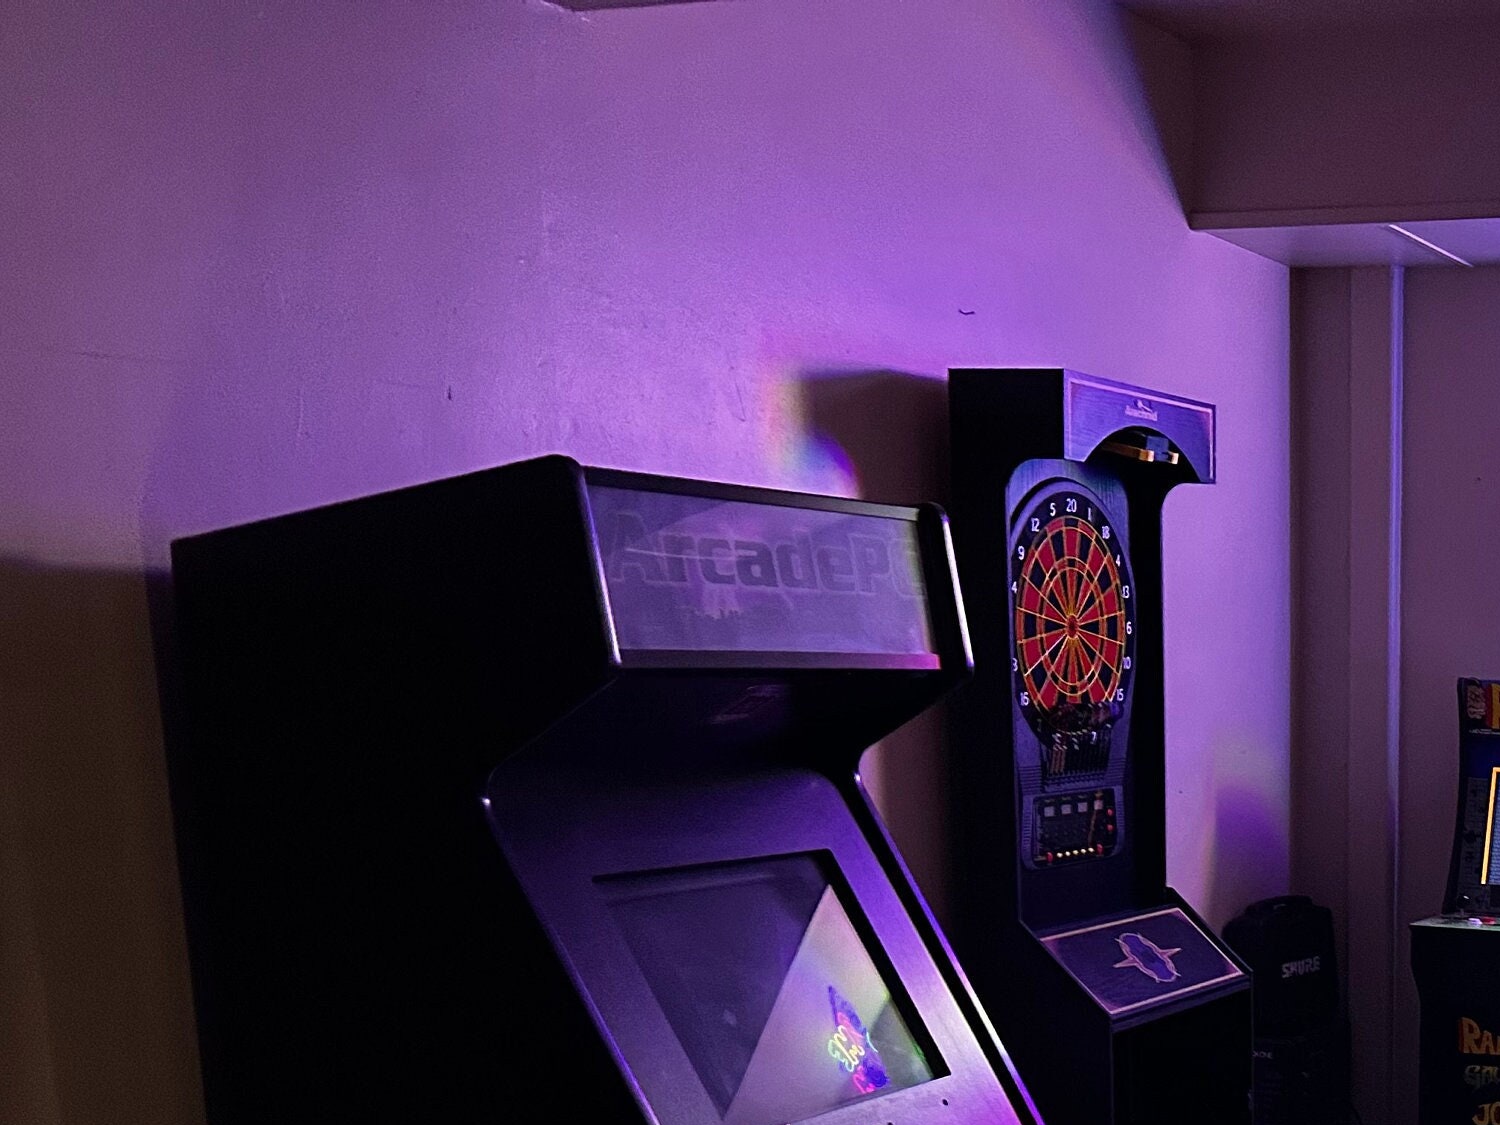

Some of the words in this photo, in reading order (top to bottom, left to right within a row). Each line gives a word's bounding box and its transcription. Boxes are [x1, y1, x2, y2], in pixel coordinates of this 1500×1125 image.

[1049, 502, 1056, 517] 5
[1066, 498, 1077, 513] 20
[1087, 507, 1092, 521] 1
[1031, 518, 1040, 532] 12
[1018, 545, 1025, 561] 9
[1115, 554, 1121, 567] 4
[1126, 621, 1132, 635] 6
[1281, 956, 1320, 979] SHURE
